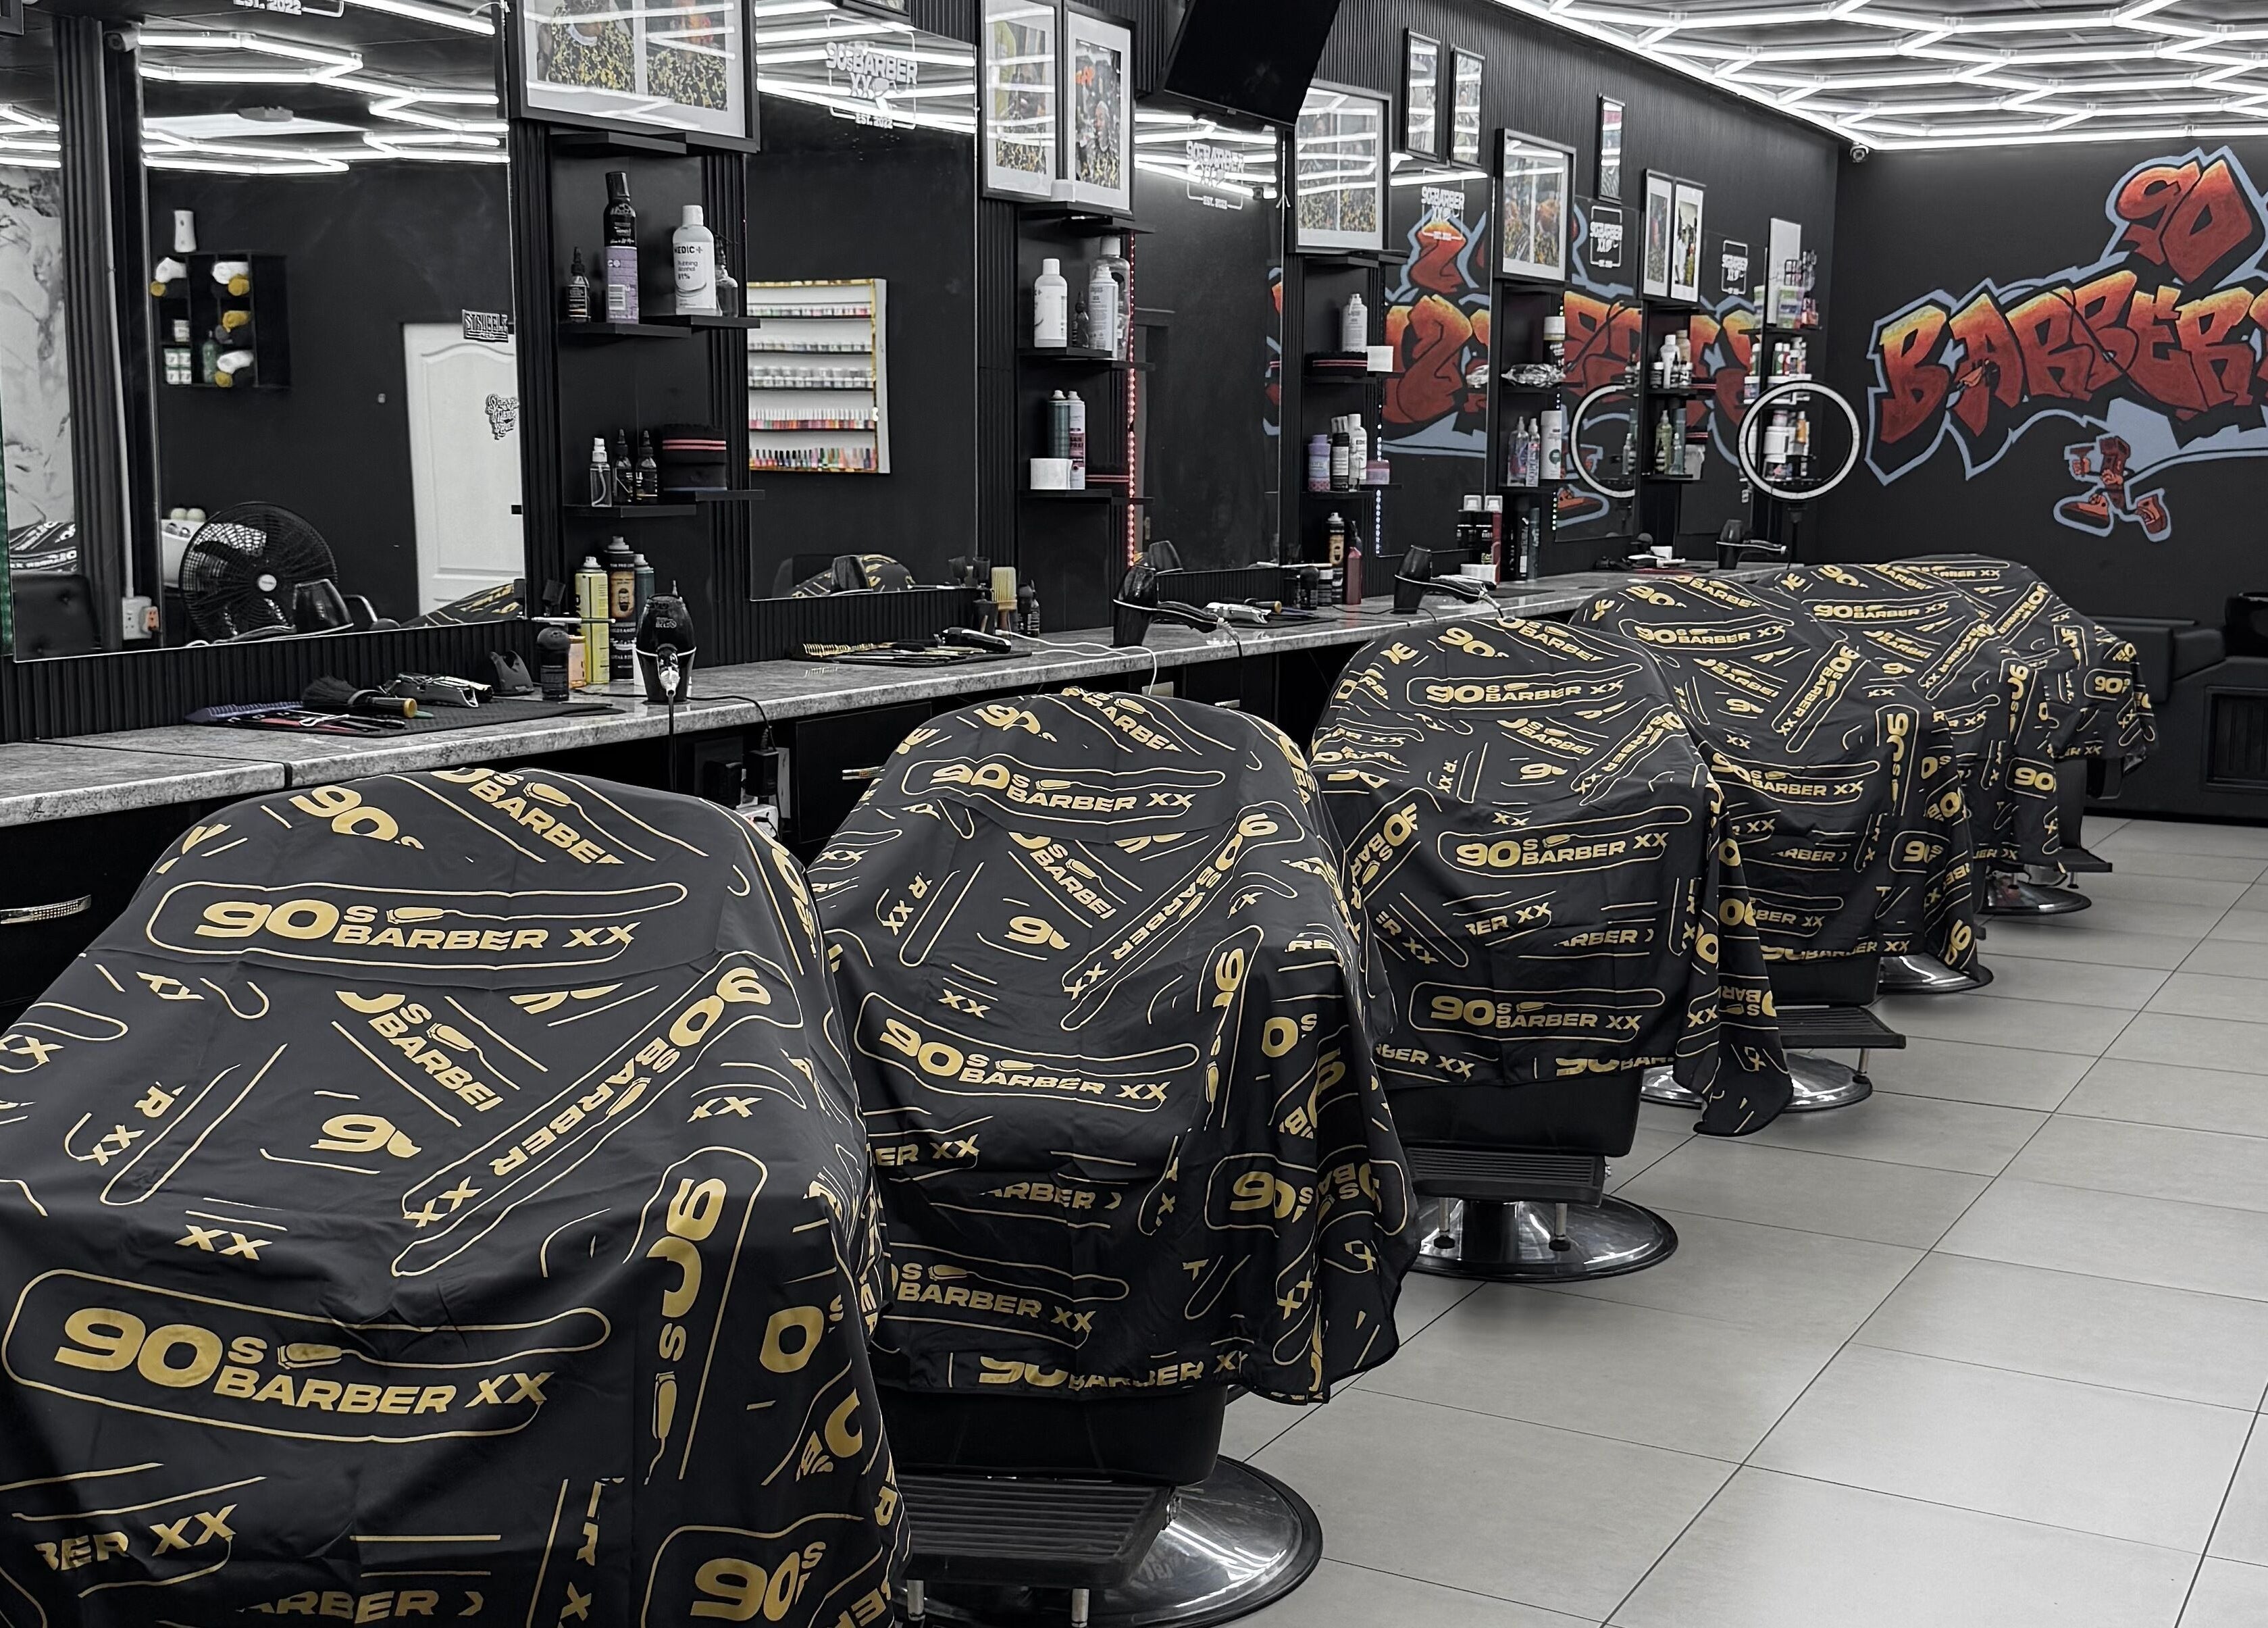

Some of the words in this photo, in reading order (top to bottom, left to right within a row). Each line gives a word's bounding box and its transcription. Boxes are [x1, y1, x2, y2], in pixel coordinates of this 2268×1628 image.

[266, 0, 302, 15] 2022
[852, 49, 918, 85] BARBER
[1878, 270, 2268, 443] BARBER
[1678, 632, 1751, 644] BARBER
[1756, 624, 1786, 638] XX
[1485, 685, 1582, 703] BARBER
[1589, 680, 1624, 695] XX
[1005, 783, 1138, 814] BARBER
[1148, 792, 1195, 811] XX
[1832, 779, 1865, 796] XX
[467, 778, 624, 865] BARBE
[1520, 839, 1628, 867] BARBER
[1632, 831, 1669, 850] XX
[1028, 847, 1116, 921] BARBE
[193, 897, 380, 941] 90S
[331, 922, 550, 952] BARBER
[562, 921, 642, 948] XX
[1514, 901, 1553, 925] XX
[1064, 960, 1108, 1000] XX
[938, 987, 989, 1019] XX
[1494, 1012, 1599, 1030] BARBER
[1607, 1015, 1643, 1032] XX
[957, 1065, 1107, 1096] BARBER
[1114, 1081, 1170, 1104] XX
[1435, 1055, 1475, 1078] XX
[488, 1034, 671, 1177] BARBER
[91, 1124, 145, 1166] XX
[933, 1134, 979, 1161] XX
[404, 1175, 484, 1228] XX
[174, 1224, 273, 1261] XX
[896, 1280, 1043, 1319] BARBER
[1051, 1305, 1096, 1334] XX
[53, 1306, 268, 1390] 90S
[212, 1364, 458, 1416] BARBER
[465, 1372, 555, 1408] XX
[149, 1504, 238, 1557] XX
